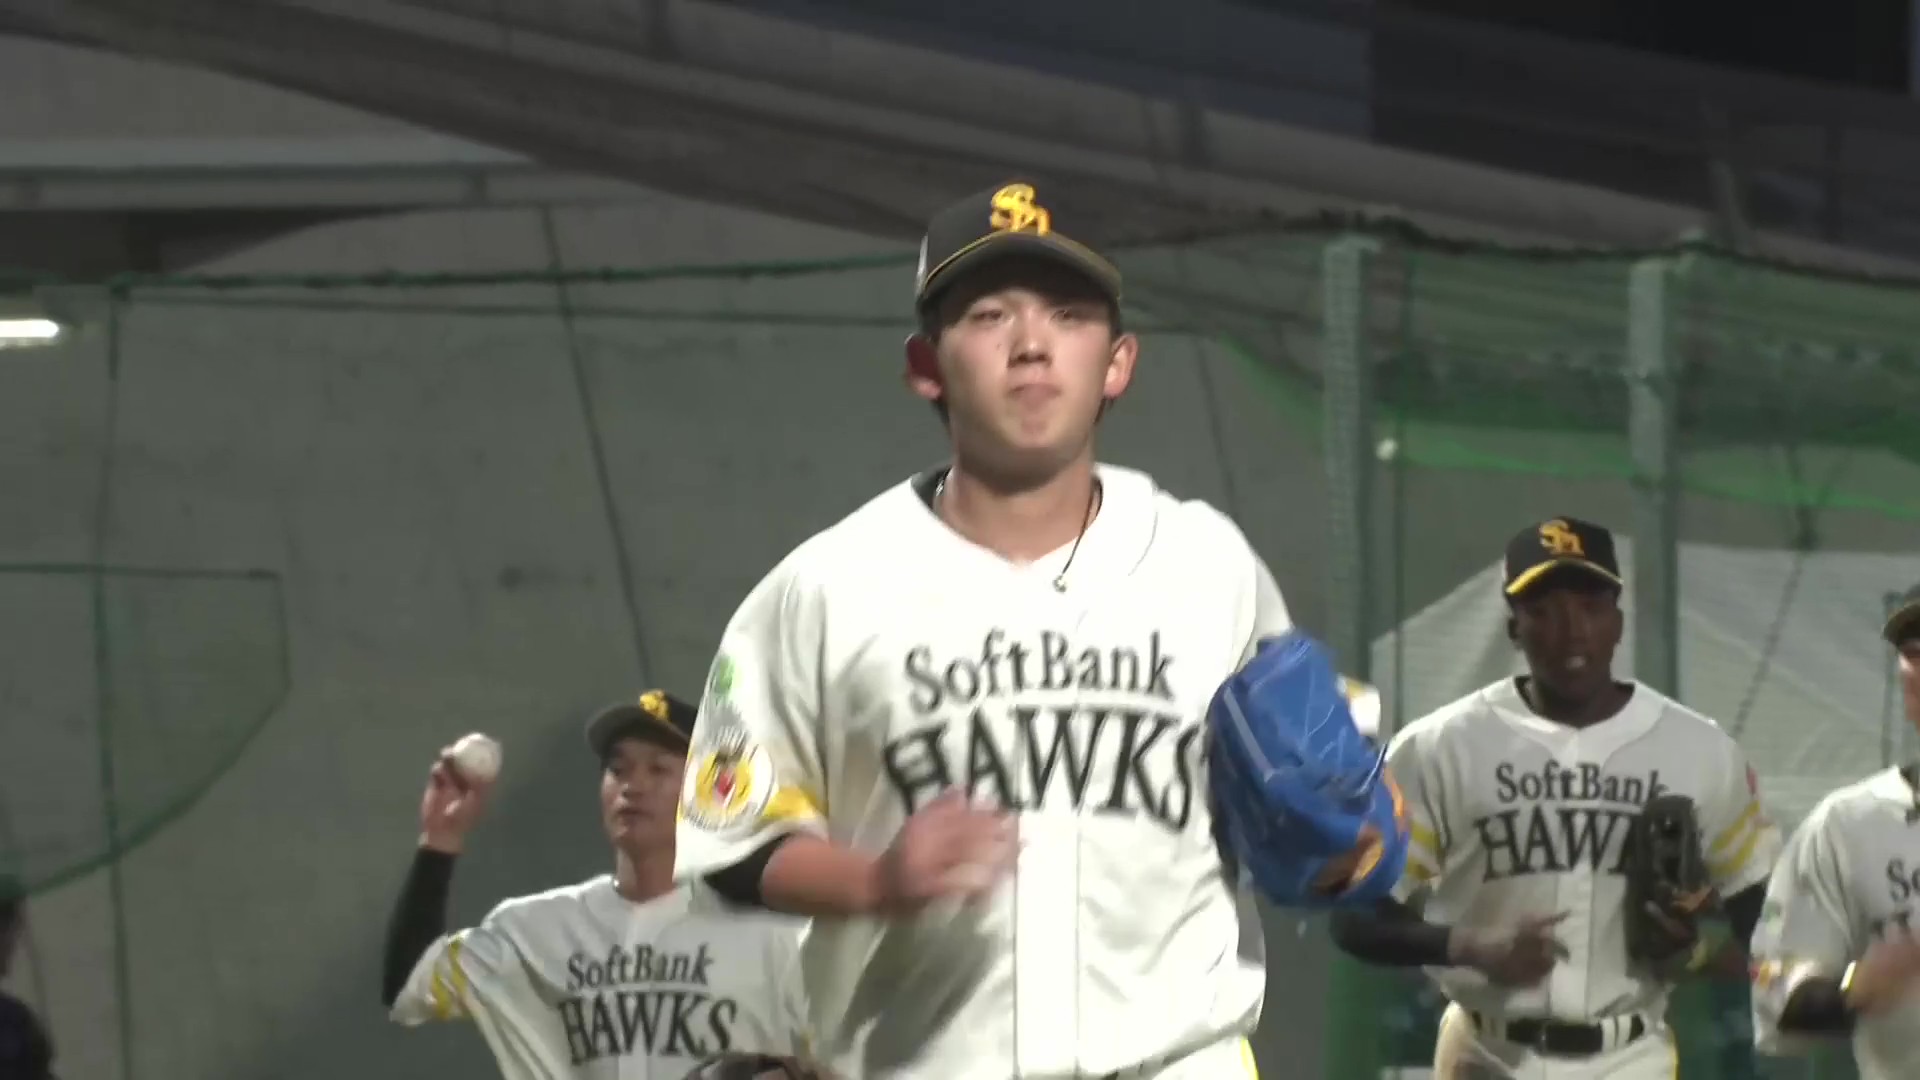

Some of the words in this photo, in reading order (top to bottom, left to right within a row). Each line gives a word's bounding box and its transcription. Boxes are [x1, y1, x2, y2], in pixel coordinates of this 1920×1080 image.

[905, 627, 1174, 713] SoftBank
[884, 704, 1202, 834] HAWKS
[1495, 759, 1669, 802] SoftBank
[1474, 805, 1636, 883] HAW
[567, 942, 713, 991] SoftBank
[558, 989, 737, 1066] HAWKS
